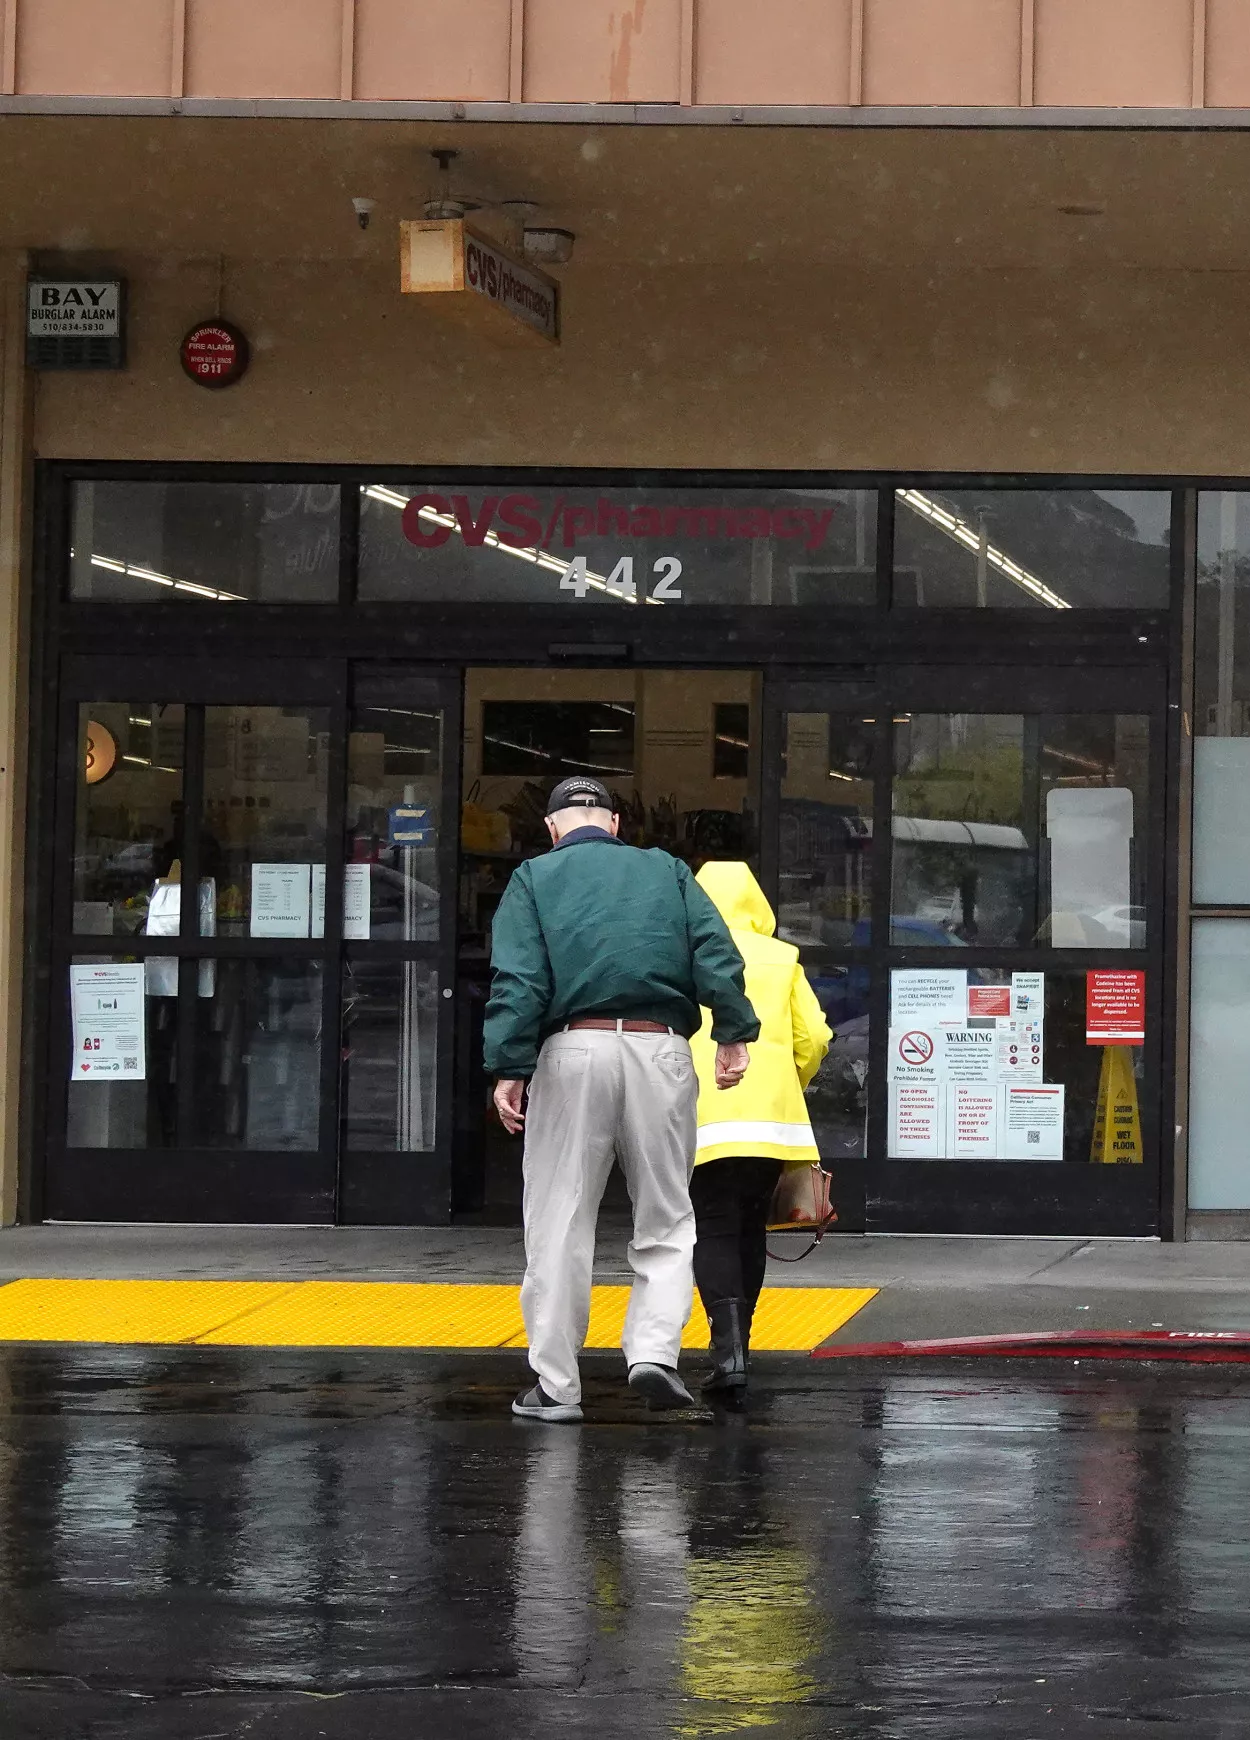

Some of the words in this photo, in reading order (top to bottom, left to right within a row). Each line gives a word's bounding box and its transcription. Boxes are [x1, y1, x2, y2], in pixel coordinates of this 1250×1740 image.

[41, 287, 107, 306] BAY
[31, 309, 75, 320] BURGLAR
[81, 309, 115, 320] ALARM
[191, 327, 232, 343] SPRINKLER
[202, 363, 221, 373] 911
[401, 493, 835, 549] CVS/pharmacy
[559, 556, 683, 599] 442
[946, 1033, 992, 1042] WARNING
[1117, 1131, 1131, 1139] WET
